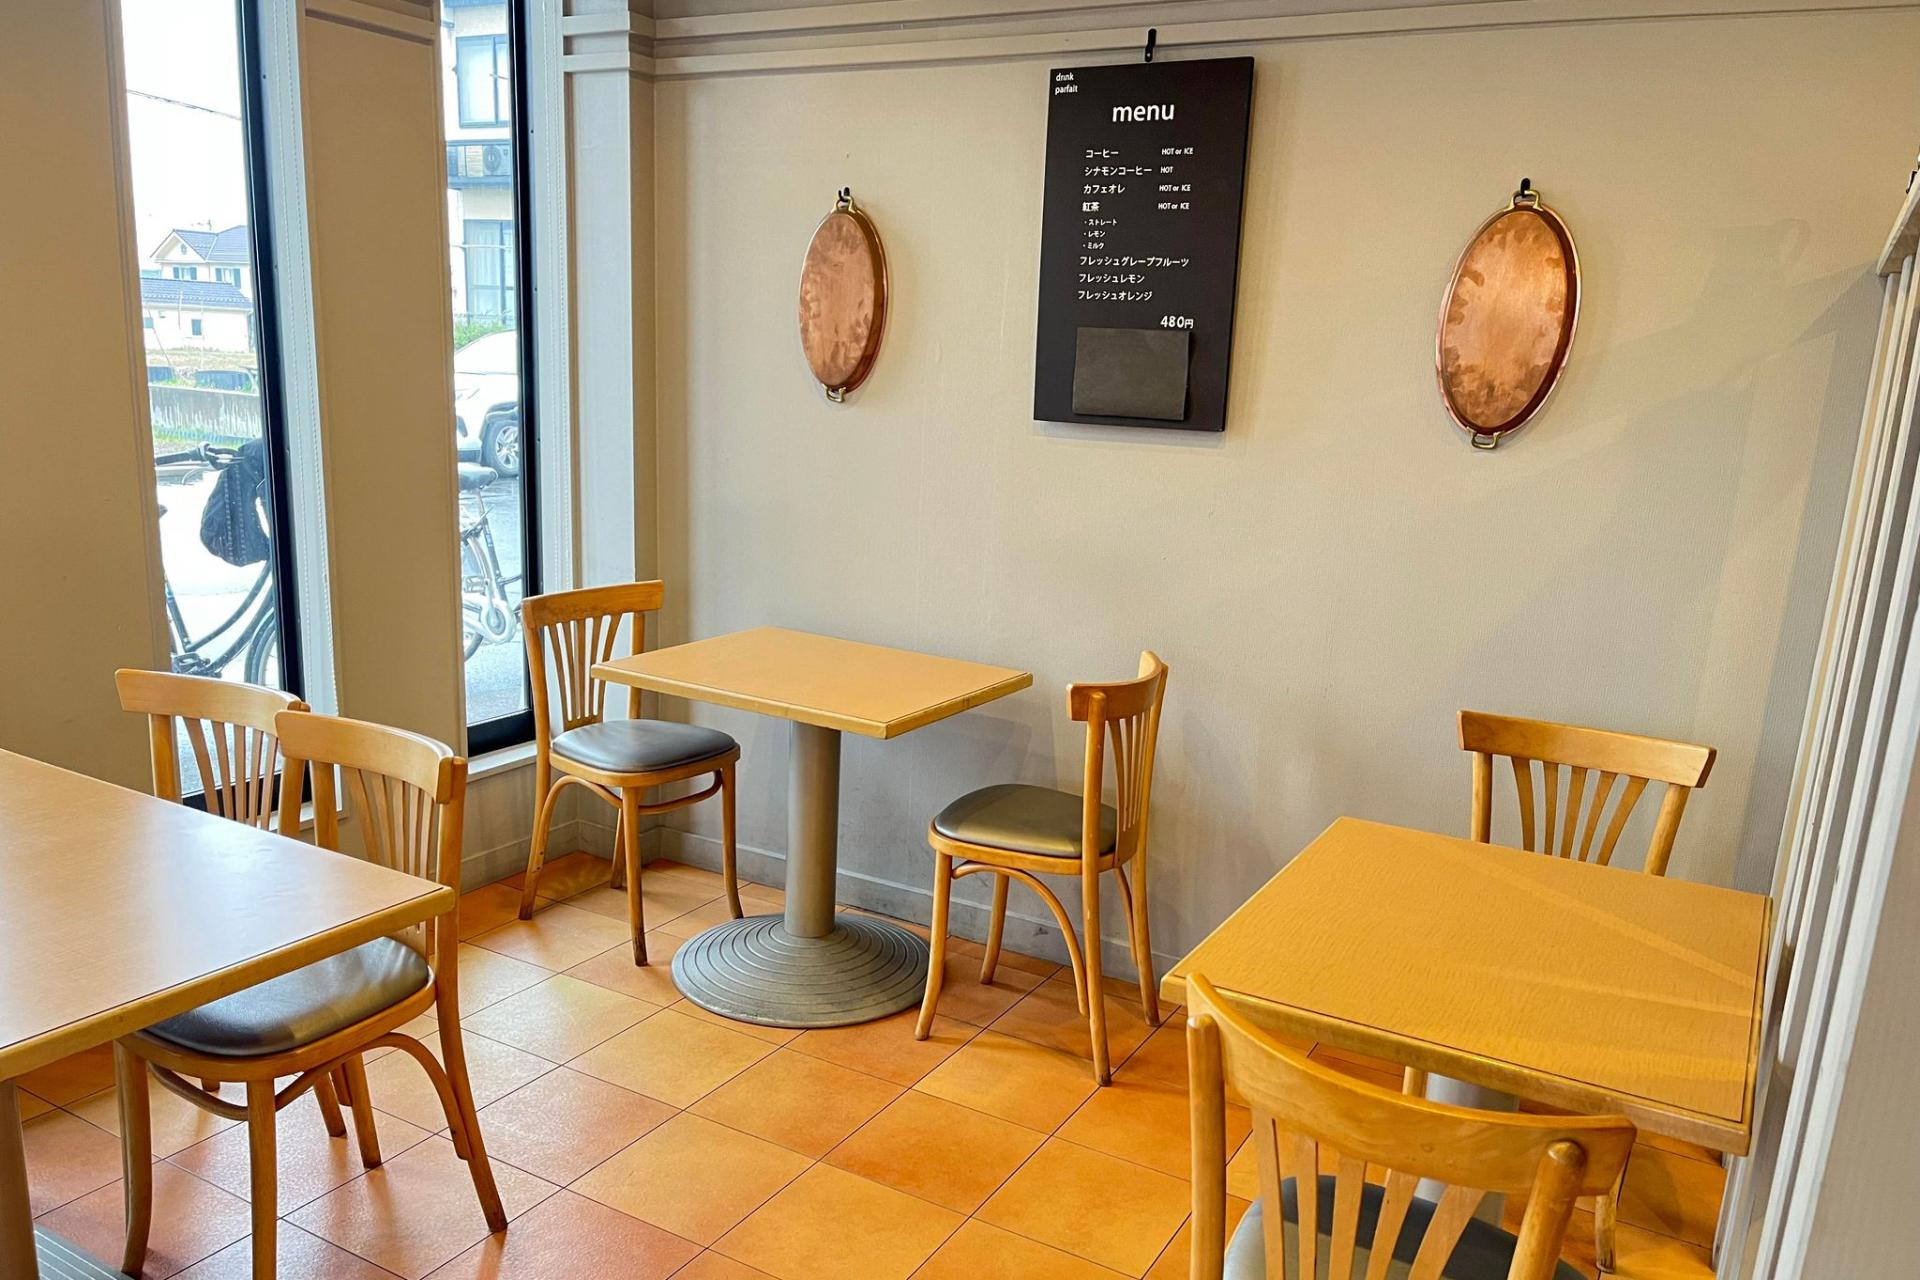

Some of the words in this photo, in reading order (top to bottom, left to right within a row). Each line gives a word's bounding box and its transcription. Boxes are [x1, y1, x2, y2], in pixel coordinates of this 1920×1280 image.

[1055, 72, 1074, 82] drink
[1054, 84, 1078, 96] parfait
[1112, 105, 1175, 123] menu
[1085, 149, 1119, 159] コーヒー
[1161, 147, 1174, 156] HOT
[1183, 147, 1194, 155] ICE
[1084, 166, 1153, 177] シナモンコーヒー
[1160, 165, 1173, 174] HOT
[1083, 184, 1126, 195] カフェオレ
[1158, 184, 1172, 192] HOT
[1181, 183, 1191, 192] ICE
[1081, 202, 1100, 213] 紅茶
[1157, 202, 1171, 210] HOT
[1179, 202, 1190, 210] ICE
[1079, 256, 1190, 268] フレッシュグレープフルーツ
[1078, 274, 1145, 284] フレッシュレモン
[1077, 291, 1153, 302] フレッシュオレンジ
[1159, 316, 1194, 329] 480円
